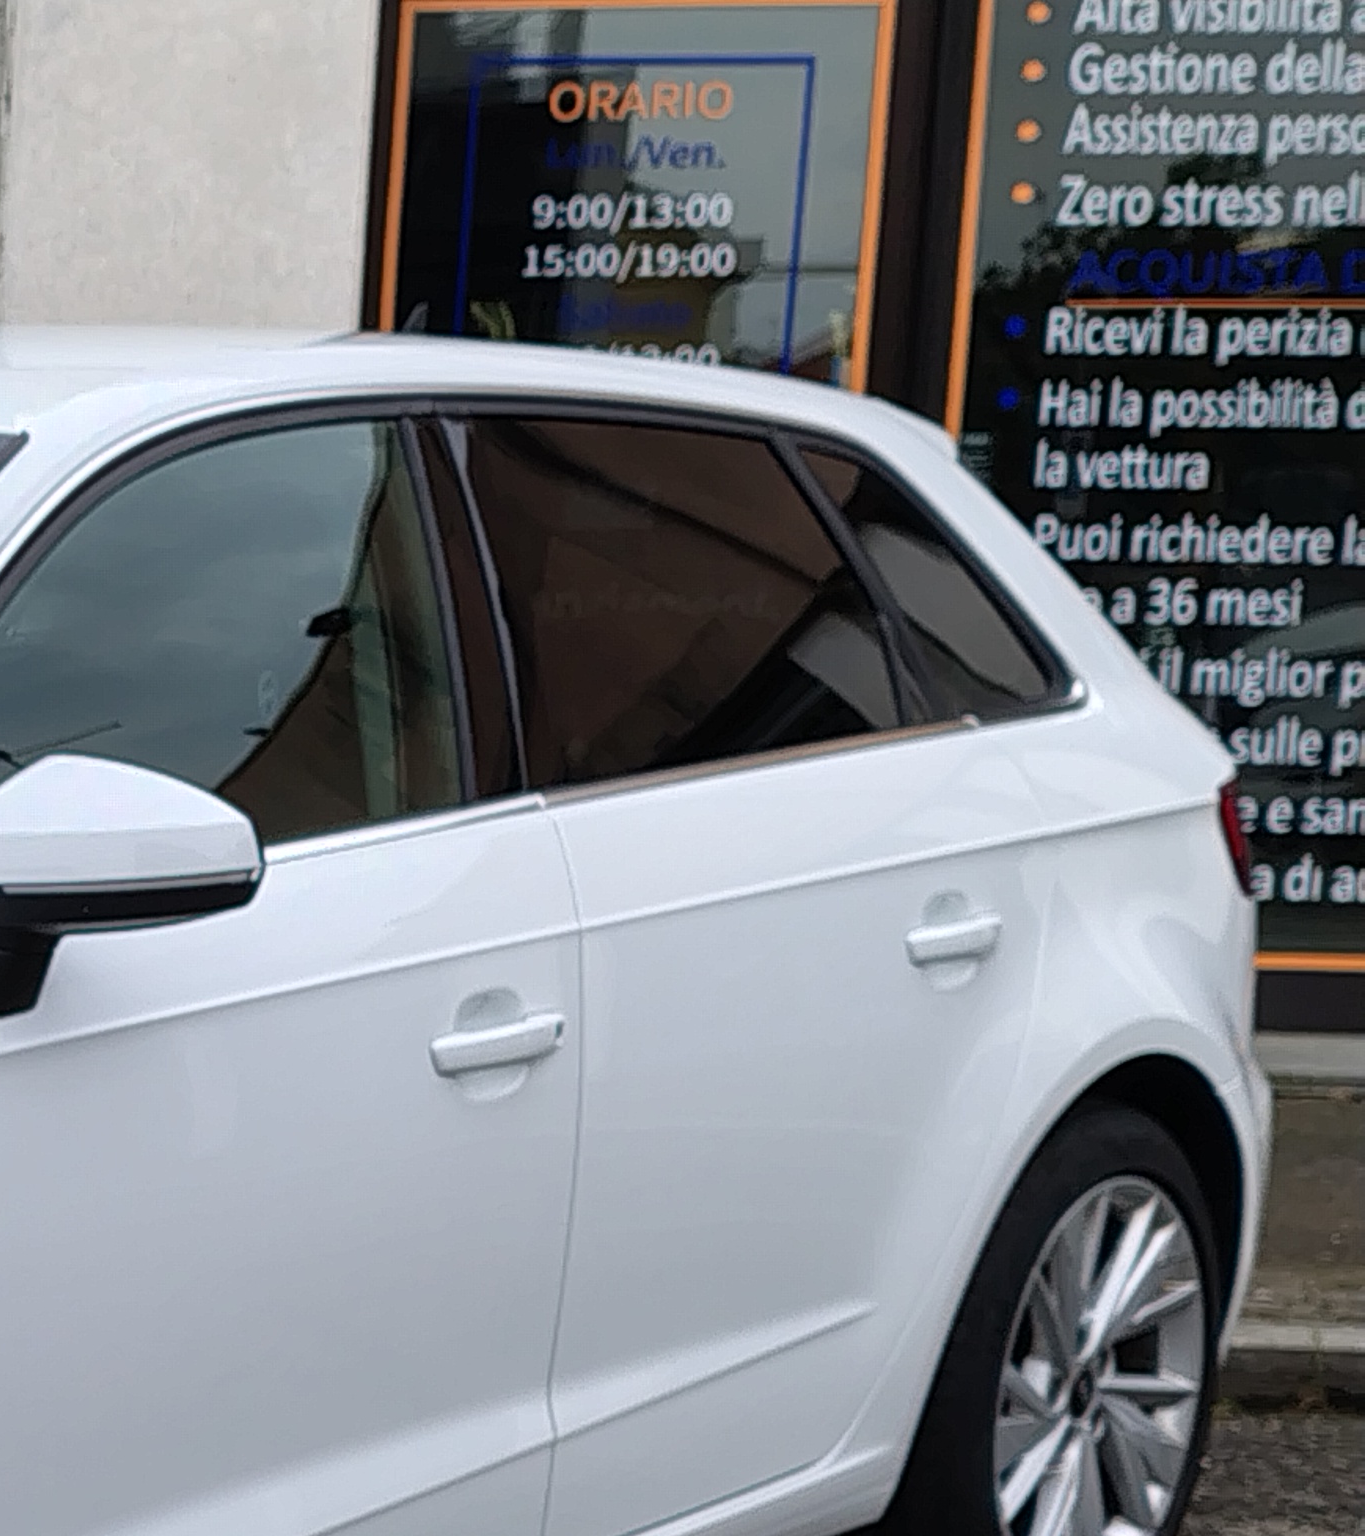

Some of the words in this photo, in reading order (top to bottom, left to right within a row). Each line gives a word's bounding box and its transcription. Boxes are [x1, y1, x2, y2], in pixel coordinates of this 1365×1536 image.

[1072, 0, 1159, 34] Alta
[1068, 42, 1258, 95] Gestione
[1265, 37, 1365, 95] della
[547, 78, 735, 123] ORARIO
[1062, 100, 1260, 155] Assistenza
[531, 191, 734, 237] 9:00/13:00
[1055, 173, 1155, 228] Zero
[1159, 177, 1285, 228] stress
[520, 241, 737, 284] 15:00/19:00
[1067, 246, 1329, 298] ACQUISTA
[1043, 305, 1165, 356] Ricevi
[1170, 303, 1209, 356] la
[1214, 306, 1354, 367] perizia
[1038, 378, 1103, 428] Hai
[1107, 375, 1144, 428] la
[1149, 376, 1339, 439] possibilità
[1033, 437, 1068, 488] la
[1076, 444, 1210, 490] vettura
[1033, 512, 1122, 561] Puoi
[1129, 511, 1335, 566] richiedere
[1110, 586, 1137, 625] a
[1143, 577, 1200, 626] 36
[1204, 578, 1304, 627] mesi
[1190, 648, 1335, 708] miglior
[1230, 714, 1323, 766] sulle
[1265, 795, 1294, 834] e
[1282, 852, 1323, 902] di
